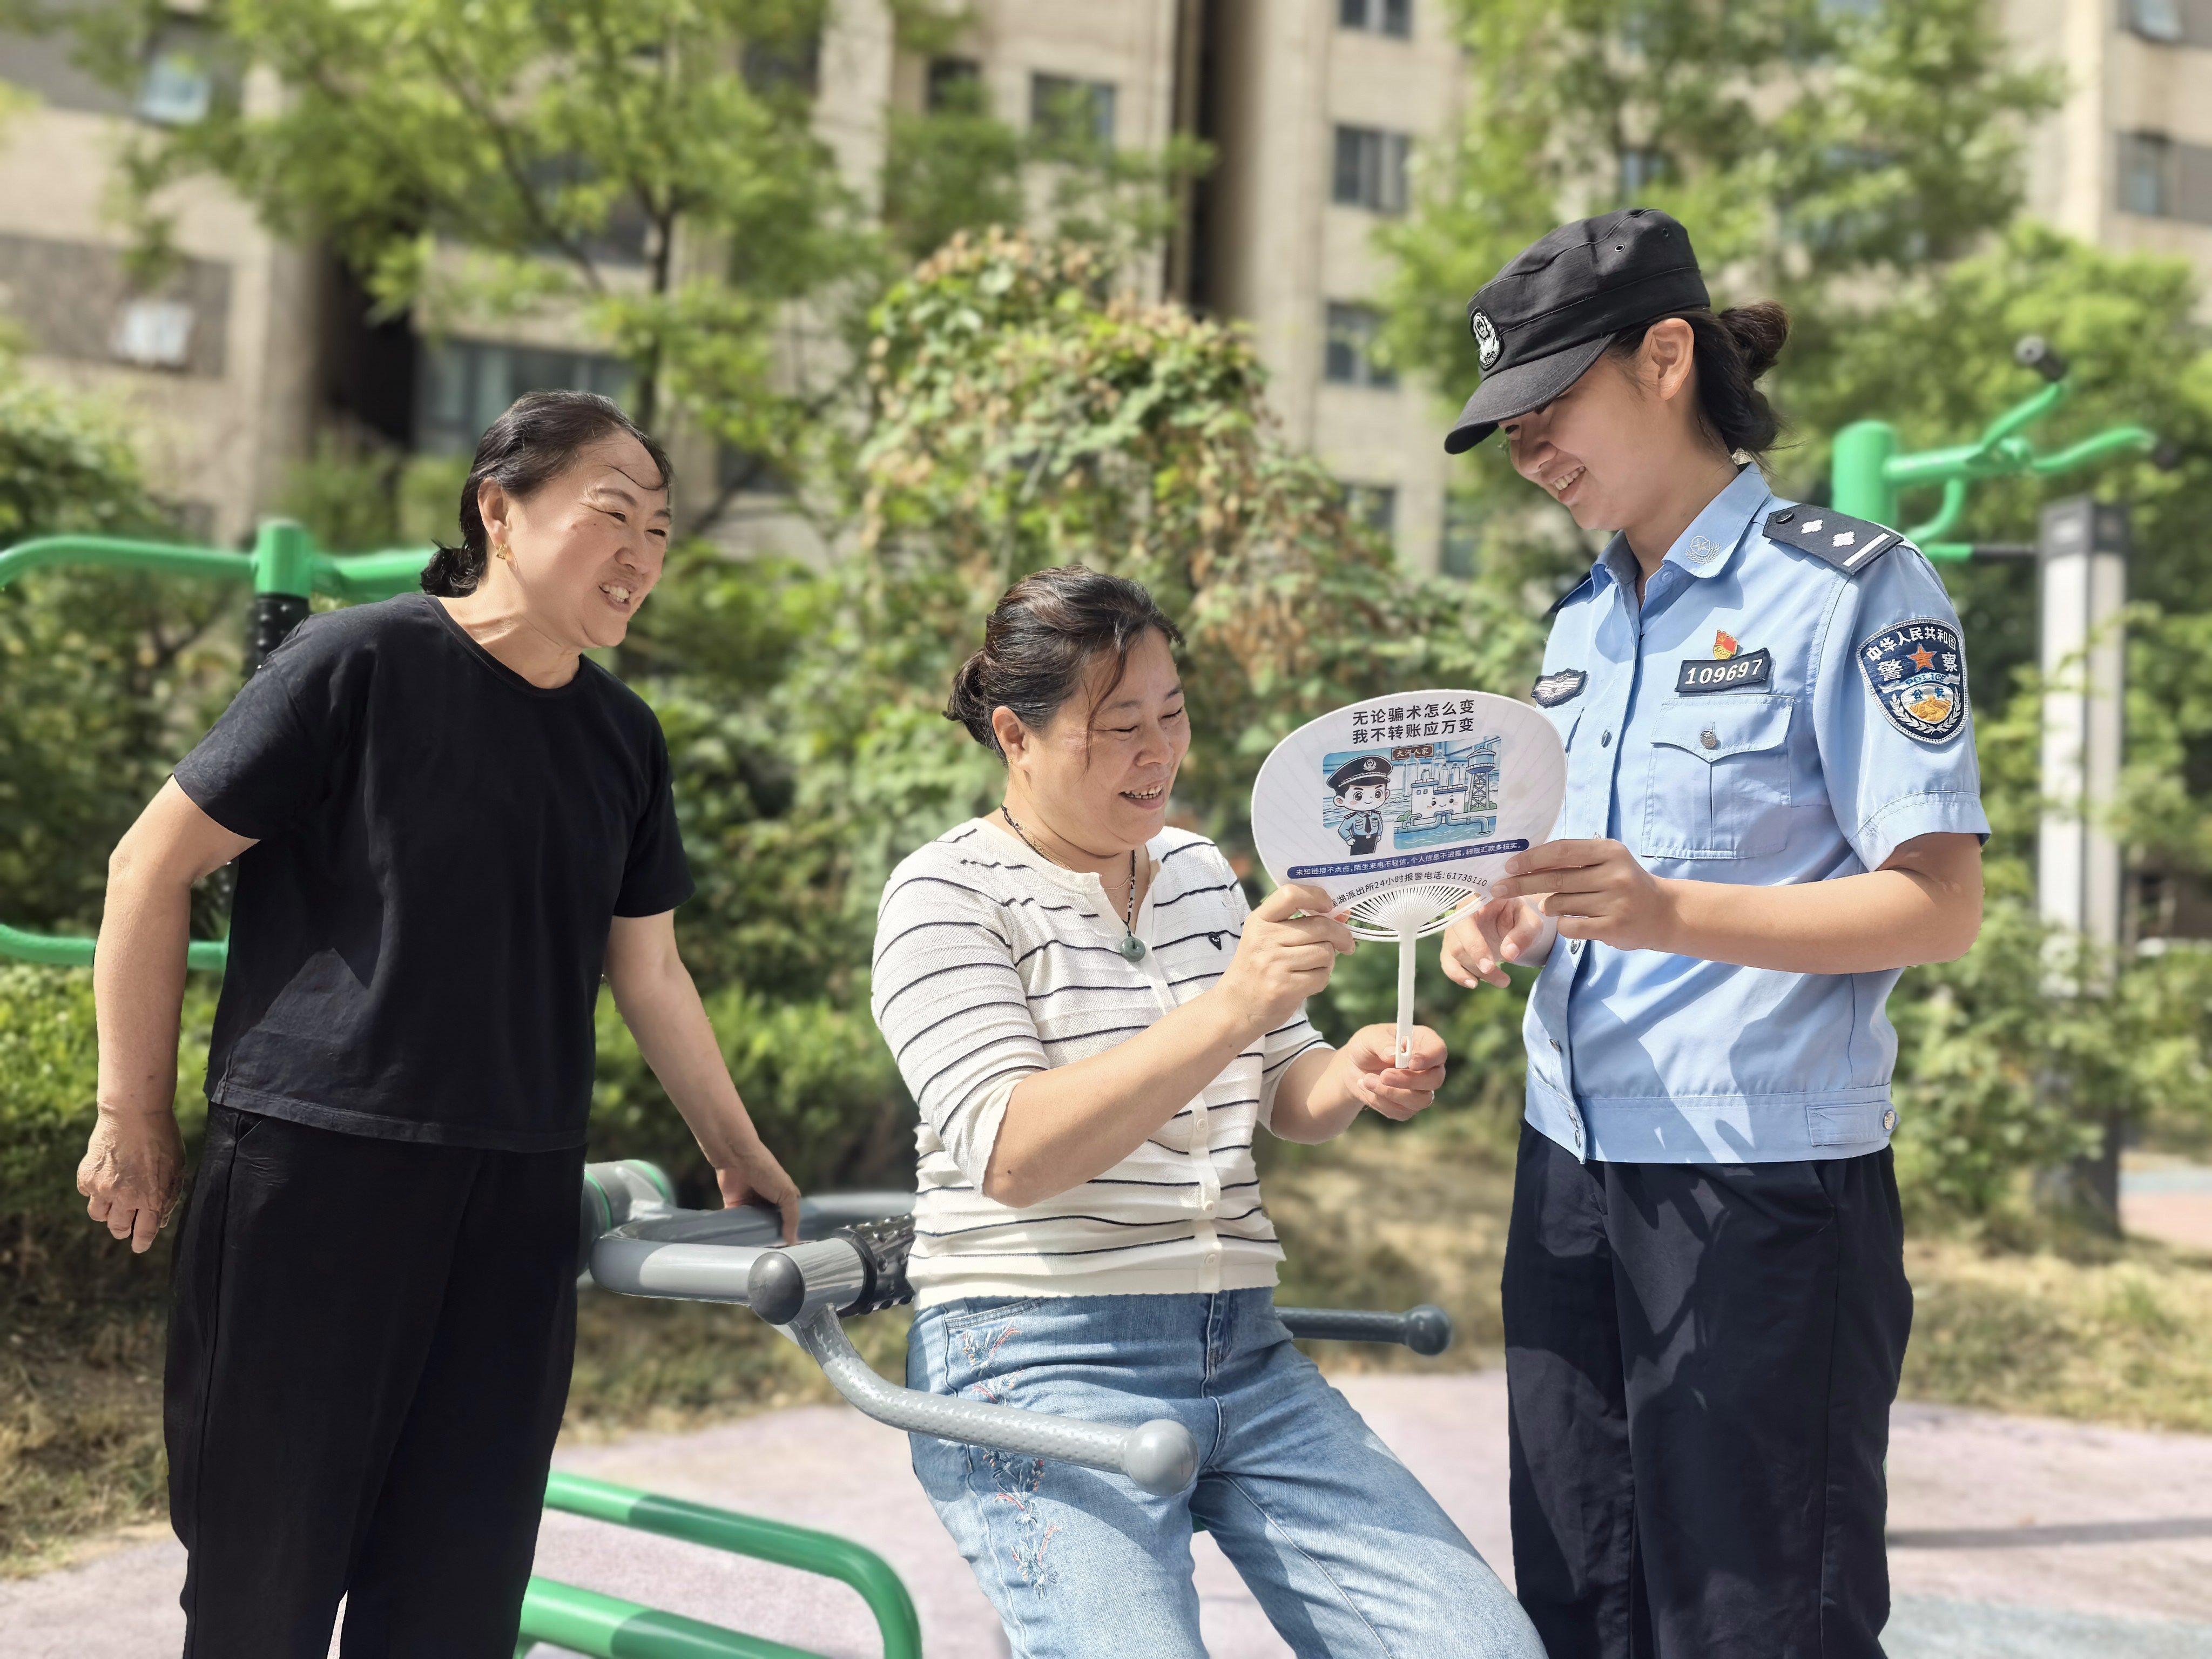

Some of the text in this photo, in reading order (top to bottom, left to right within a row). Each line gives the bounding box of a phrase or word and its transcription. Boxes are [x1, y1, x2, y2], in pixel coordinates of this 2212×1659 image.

[1865, 626, 1956, 662] 中华人民共和国
[1685, 658, 1763, 685] 109697
[1905, 673, 1946, 686] POLICE
[1352, 699, 1475, 726] 无论骗术怎么变
[1352, 717, 1474, 745] 我不转账应万变
